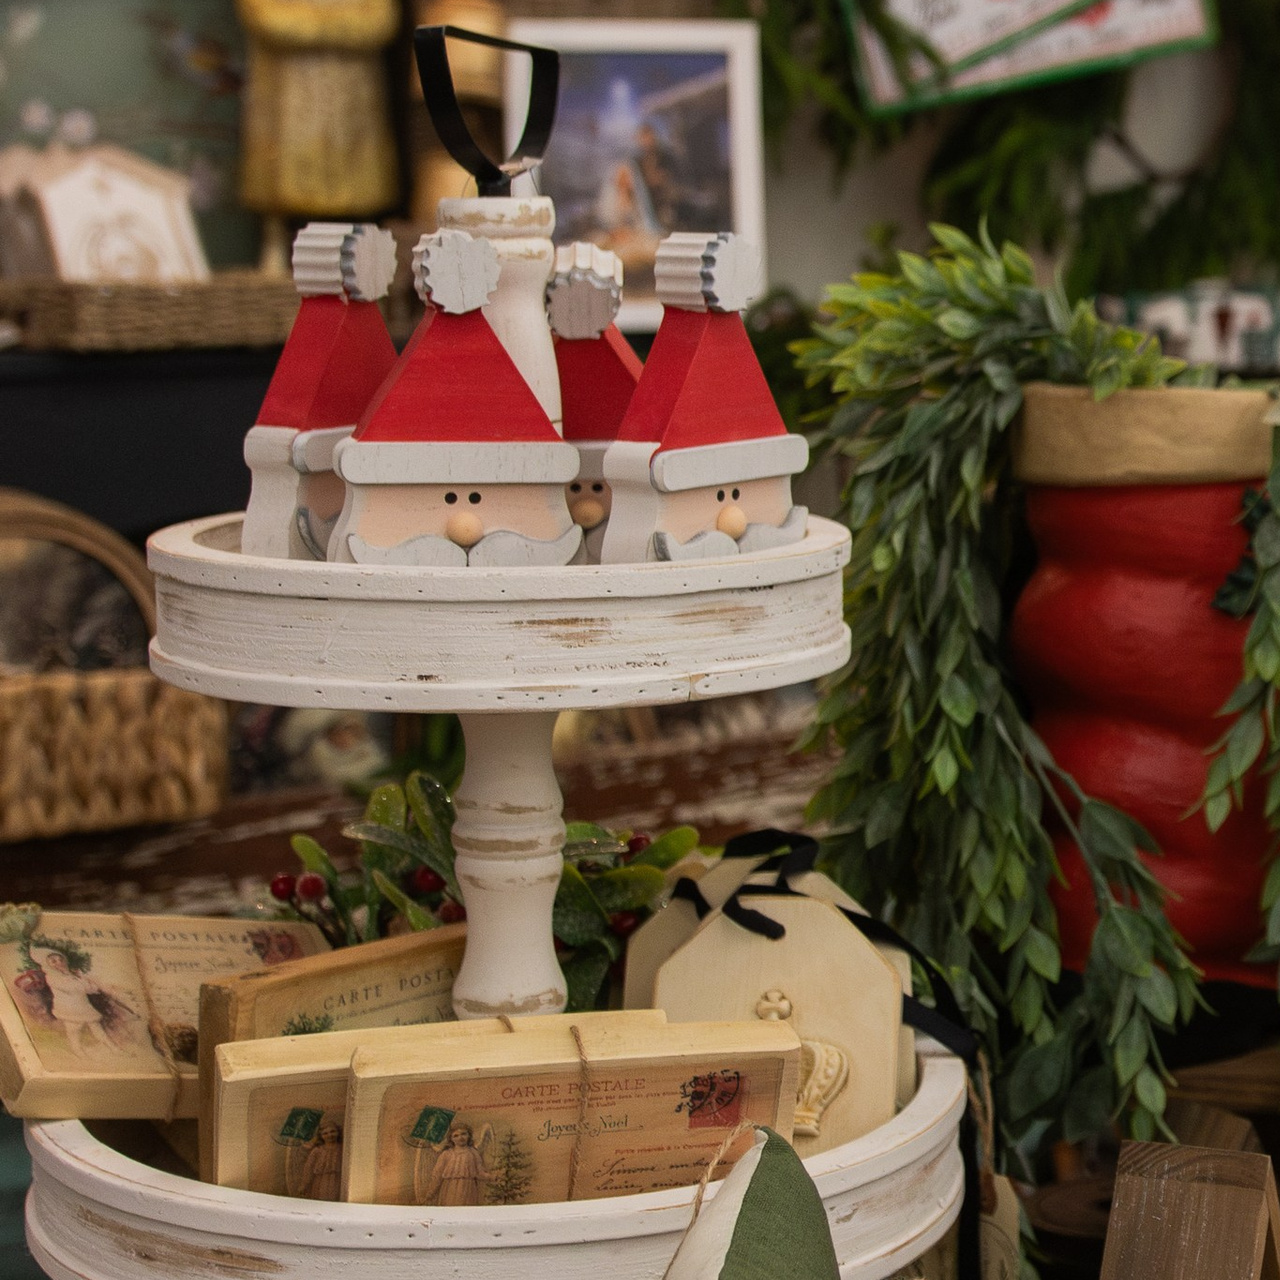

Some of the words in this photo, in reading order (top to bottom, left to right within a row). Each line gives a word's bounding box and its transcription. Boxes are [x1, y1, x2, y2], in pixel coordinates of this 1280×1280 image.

[322, 983, 383, 1010] CARTE
[501, 1084, 560, 1100] CARTE
[567, 1078, 646, 1095] POSTALE
